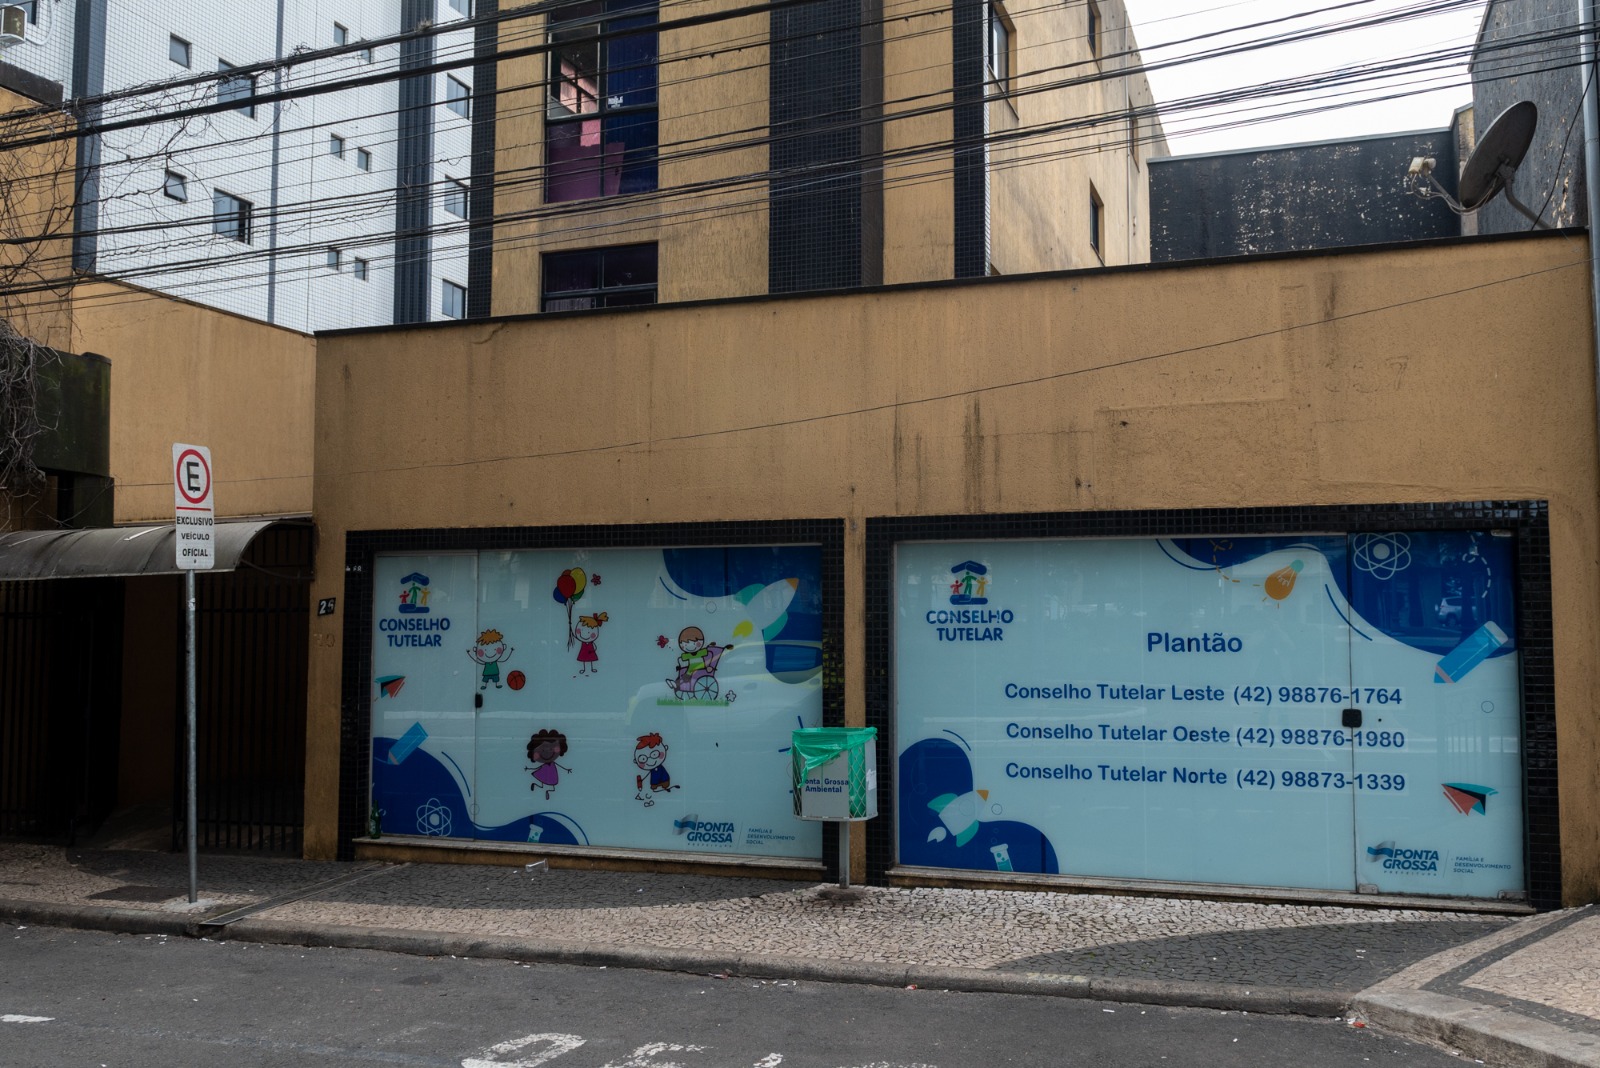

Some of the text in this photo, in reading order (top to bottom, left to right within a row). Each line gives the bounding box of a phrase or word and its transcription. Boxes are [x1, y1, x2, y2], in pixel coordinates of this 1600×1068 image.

[186, 461, 201, 492] E
[176, 516, 214, 526] EXCLUSIVO
[181, 531, 210, 540] VEÍCULO
[926, 609, 1014, 624] CONSELHO
[379, 617, 450, 631] CONSELHO
[387, 634, 442, 647] TUTELAR
[936, 627, 1003, 641] TUTELAR
[1147, 632, 1243, 653] Plantão
[1004, 683, 1402, 705] Conselho Tutelar Leste (42) 98876-1764
[1006, 723, 1405, 748] Conselho Tutelar Oeste (42) 98876-1980
[1005, 762, 1405, 790] Conselho Tutelar Norte (42) 98873-1339
[805, 785, 842, 793] Ambiental
[696, 821, 735, 832] PONTA
[687, 831, 733, 843] GROSSA
[1393, 848, 1439, 861] PONTA
[1383, 858, 1437, 871] GROSSA
[1455, 862, 1511, 870] DESENVOLVIMENTO
